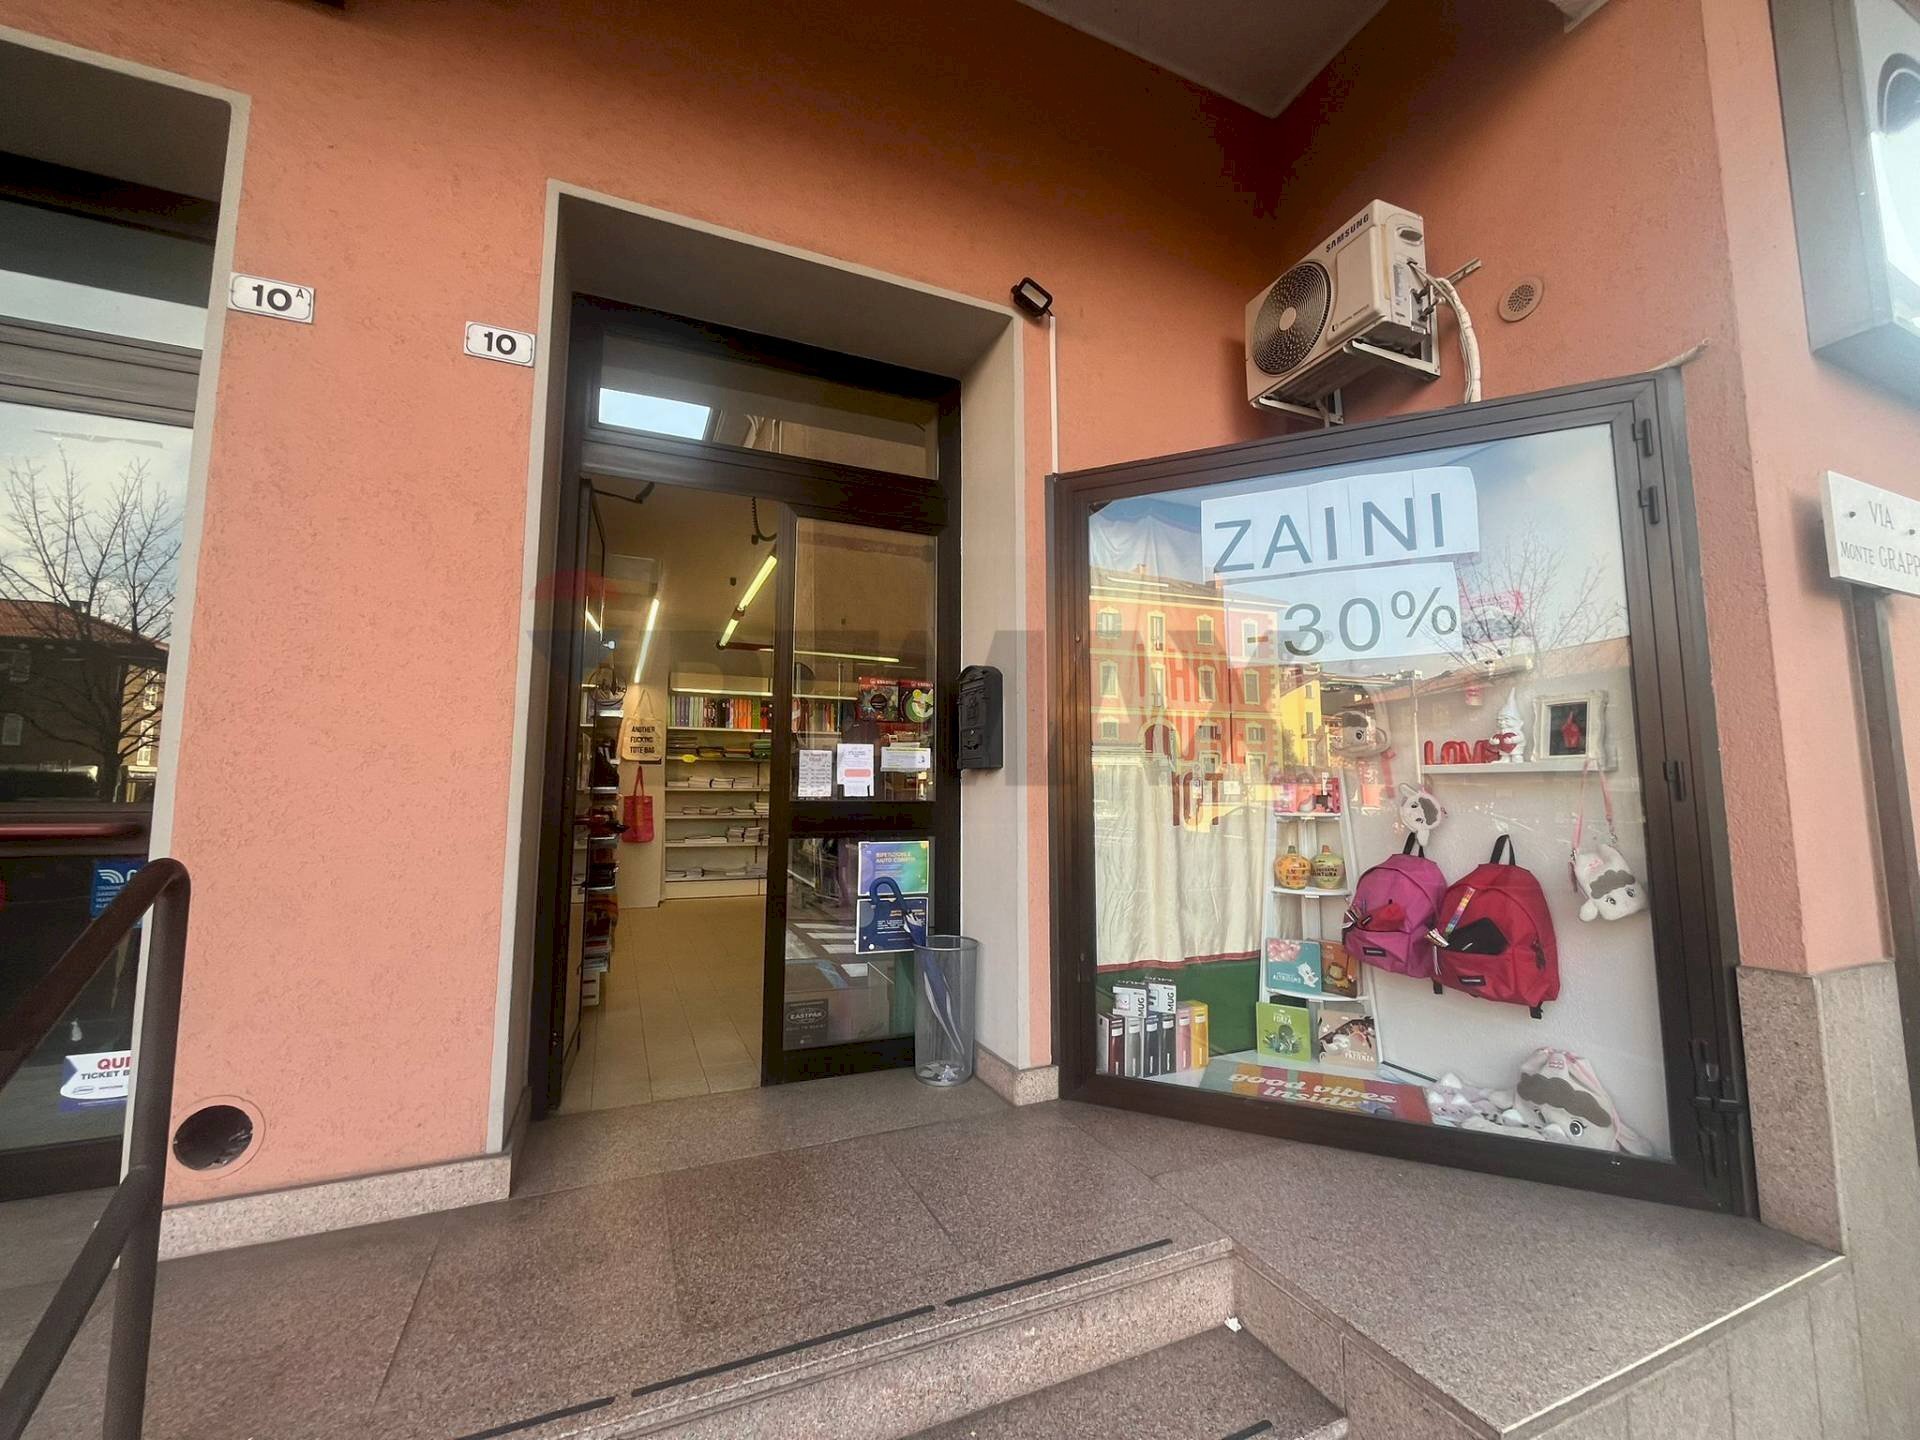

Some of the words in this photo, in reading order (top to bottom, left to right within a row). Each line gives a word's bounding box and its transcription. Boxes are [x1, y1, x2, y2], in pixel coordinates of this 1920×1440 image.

[1326, 213, 1369, 252] SAMSUNG
[484, 331, 517, 355] 10
[1868, 501, 1895, 529] VIA
[1213, 493, 1444, 573] ZAINI
[1840, 541, 1875, 565] MONTE
[1137, 997, 1145, 1016] MUG
[1167, 992, 1175, 1012] MUG
[81, 1070, 118, 1080] TICKET
[1313, 1084, 1397, 1103] vibes
